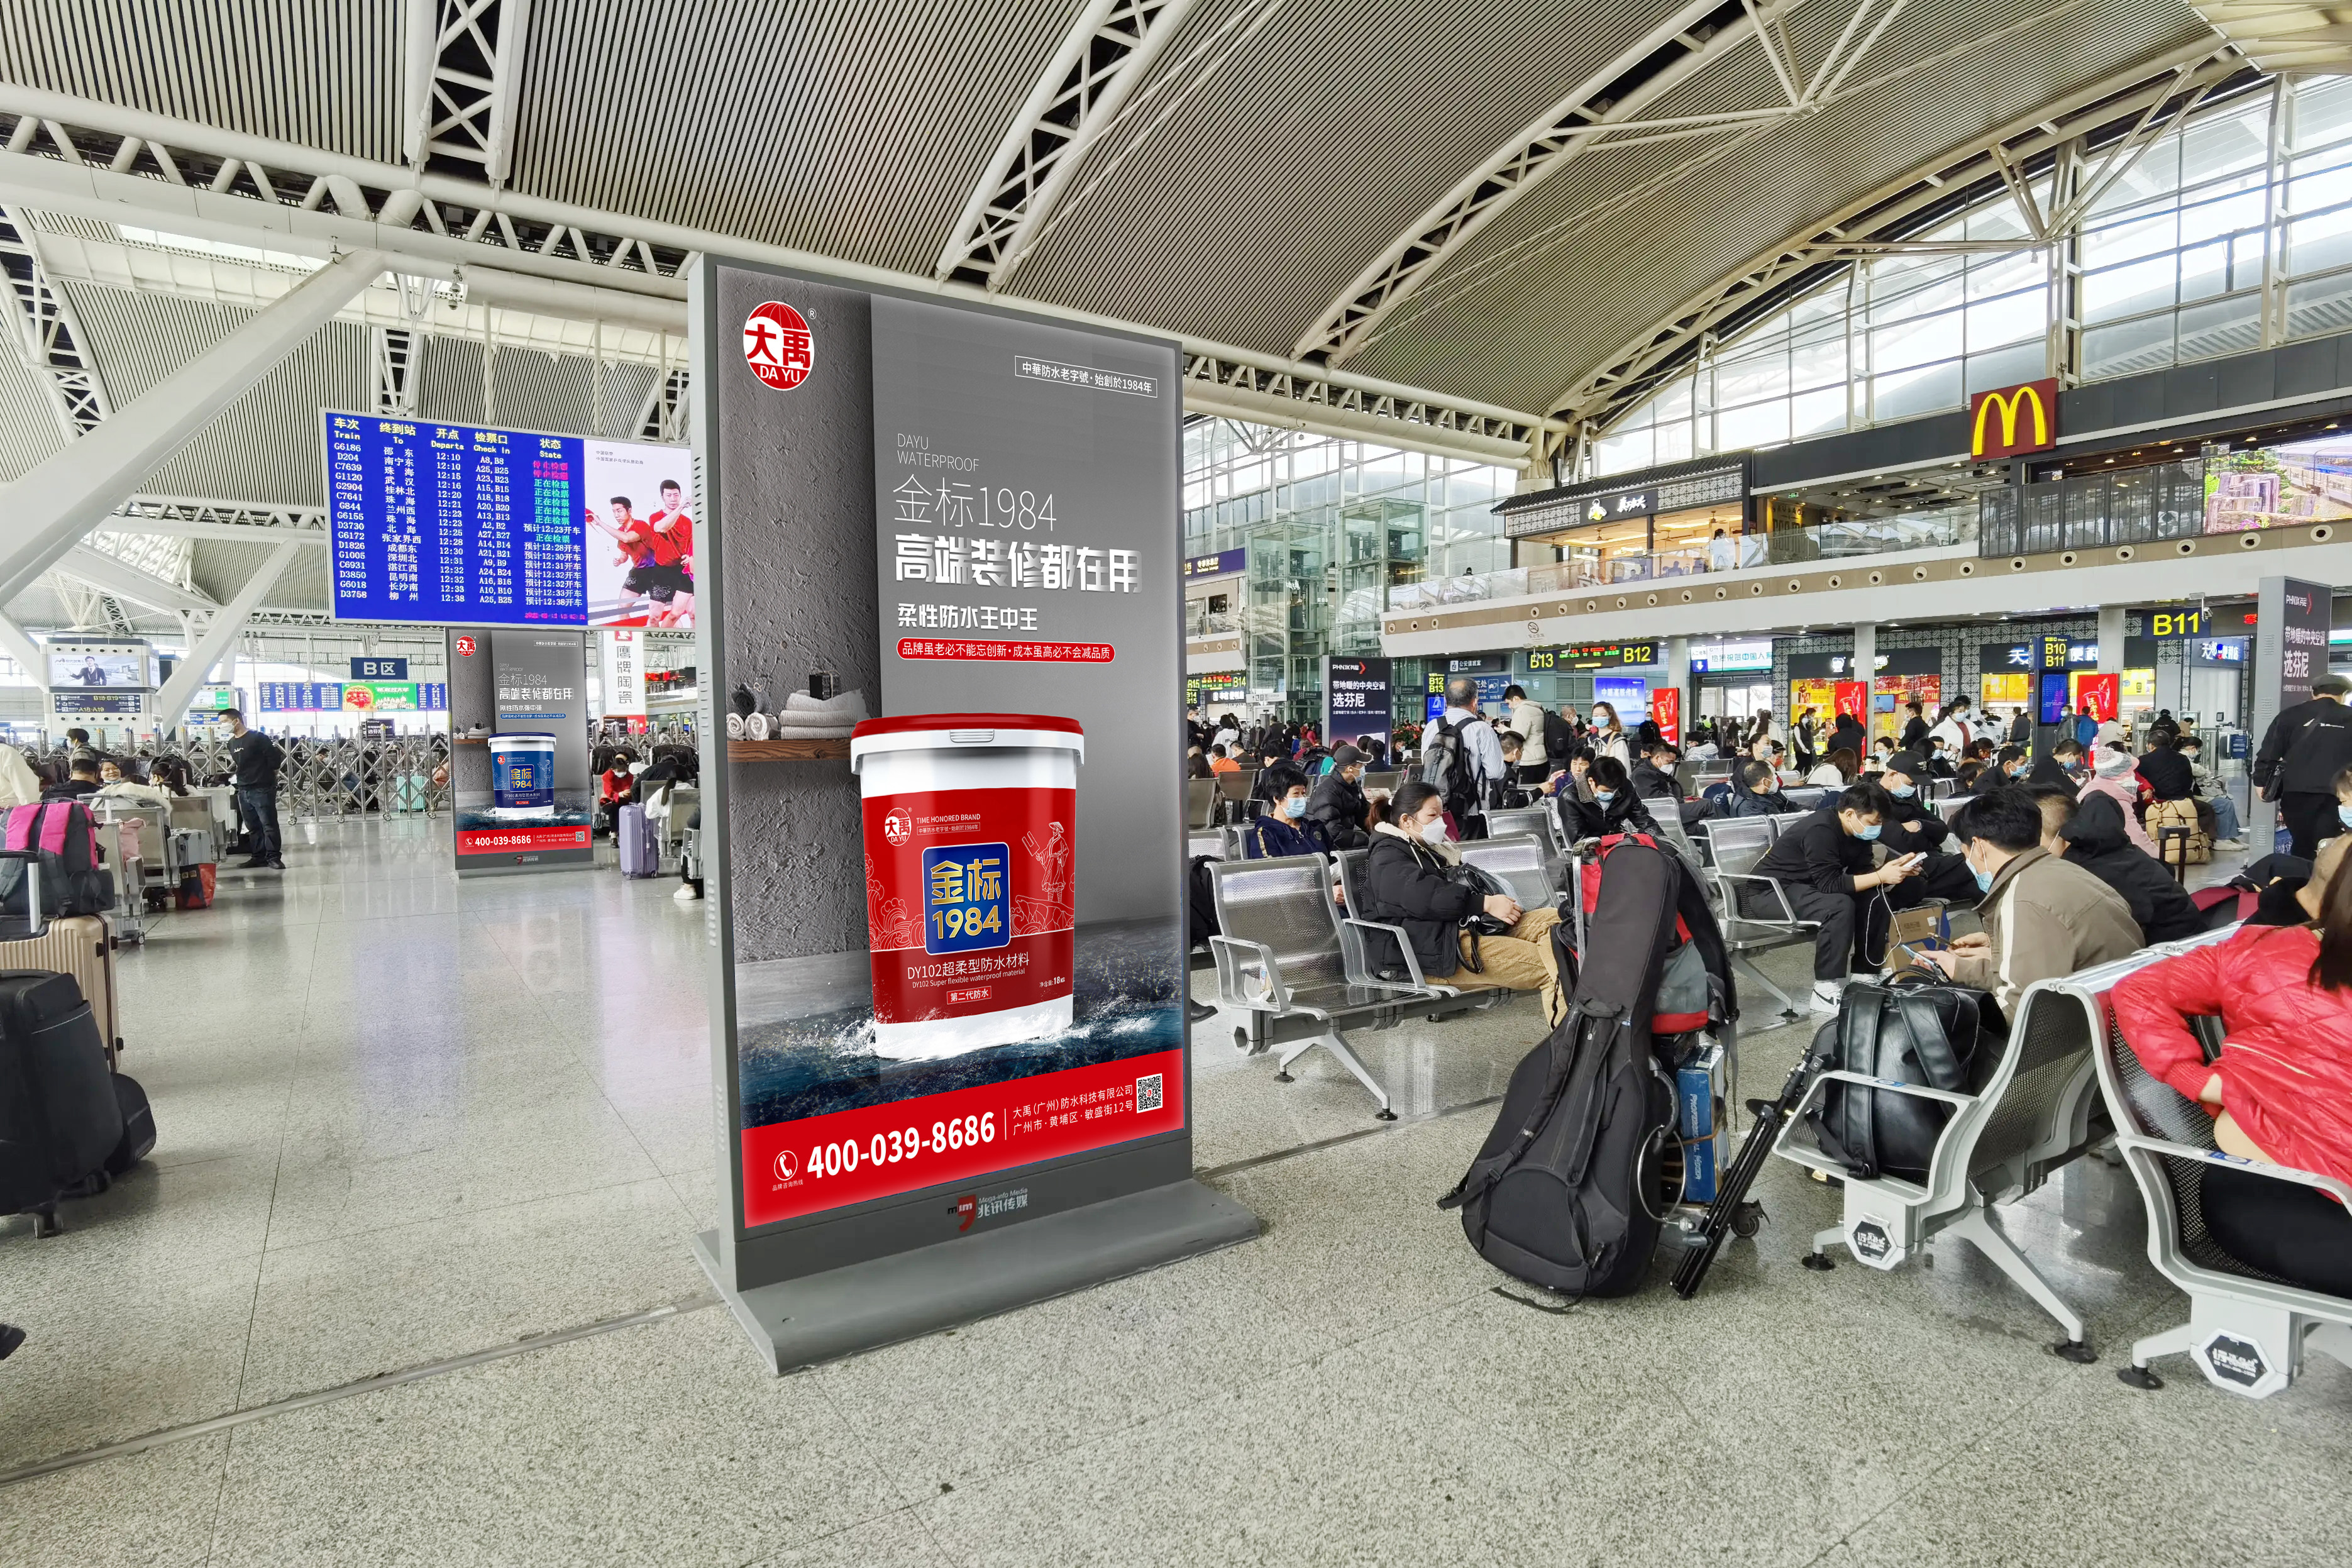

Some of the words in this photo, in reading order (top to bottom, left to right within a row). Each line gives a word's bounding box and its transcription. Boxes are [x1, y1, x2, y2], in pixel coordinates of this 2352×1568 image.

[744, 323, 811, 369] 大禹
[334, 416, 360, 430] 车次
[379, 421, 416, 436] 终到站
[334, 430, 360, 439] Train
[392, 436, 403, 444] To
[435, 428, 459, 439] 开点
[474, 431, 507, 444] 检票口
[539, 438, 561, 450] 状态
[897, 433, 929, 450] DAYU
[333, 442, 361, 451] G6186
[436, 452, 460, 461] 12:10
[539, 450, 561, 458] State
[337, 452, 358, 461] D204
[384, 456, 414, 467] 南宁东
[436, 461, 460, 470] 12:10
[897, 450, 980, 472] WATERPROOF
[334, 462, 362, 471] C7639
[437, 471, 461, 480] 12:15
[335, 472, 362, 481] G1120
[437, 480, 461, 489] 12:16
[336, 482, 362, 491] G2904
[384, 485, 415, 495] 桂林北
[438, 490, 461, 499] 12:20
[336, 492, 362, 500] C7641
[438, 499, 461, 508] 12:21
[893, 474, 1057, 531] 金标1984
[339, 502, 360, 511] G844
[385, 504, 415, 515] 兰州西
[438, 509, 461, 517] 12:23
[336, 511, 363, 520] G6155
[439, 519, 462, 527] 12:23
[337, 521, 365, 530] D3730
[337, 531, 364, 539] G6172
[382, 533, 421, 544] 张家界西
[439, 538, 463, 546] 12:28
[338, 541, 365, 549] D1826
[387, 543, 417, 553] 成都东
[439, 546, 463, 555] 12:30
[338, 551, 365, 559] G1005
[387, 553, 417, 563] 深圳北
[895, 533, 1143, 594] 高端装修都在用
[339, 560, 365, 569] C6931
[387, 562, 417, 572] 湛江西
[339, 570, 366, 578] D3850
[389, 572, 417, 582] 昆明南
[340, 580, 367, 588] G6018
[389, 582, 418, 592] 长沙南
[440, 584, 464, 592] 12:33
[340, 590, 367, 598] D3758
[898, 603, 1038, 631] 柔性防水王中王
[2153, 612, 2199, 636] B11
[1624, 646, 1651, 663] B12
[2045, 643, 2066, 654] B10
[1530, 653, 1554, 668] B13
[2045, 656, 2064, 667] B11
[2283, 649, 2309, 678] 选芬尼
[498, 673, 548, 686] 金标1984
[617, 645, 632, 704] 鹰牌陶瓷
[1233, 676, 1246, 687] B14
[1188, 679, 1200, 688] B15
[1332, 681, 1386, 690] 带地暖的中央空调
[499, 688, 575, 700] 高端装修都在用
[1333, 693, 1366, 707] 选芬尼
[511, 768, 532, 780] 金标
[512, 780, 532, 788] 1984
[931, 815, 959, 823] HONORED
[475, 835, 531, 846] 400-039-8686
[930, 858, 1002, 905] 金标
[932, 905, 1002, 939] 1984
[907, 951, 1030, 980] DY102超柔型防水材料
[912, 980, 929, 988] DY102
[930, 978, 946, 988] Super
[947, 976, 969, 985] flexible
[969, 971, 1002, 983] waterproof
[1002, 968, 1025, 978] material
[950, 988, 989, 1002] 第二代防水
[807, 1112, 995, 1179] 400-039-8686
[772, 1179, 804, 1191] 品牌咨询热线
[1010, 1187, 1028, 1196] Media
[977, 1194, 1028, 1218] 兆讯传媒
